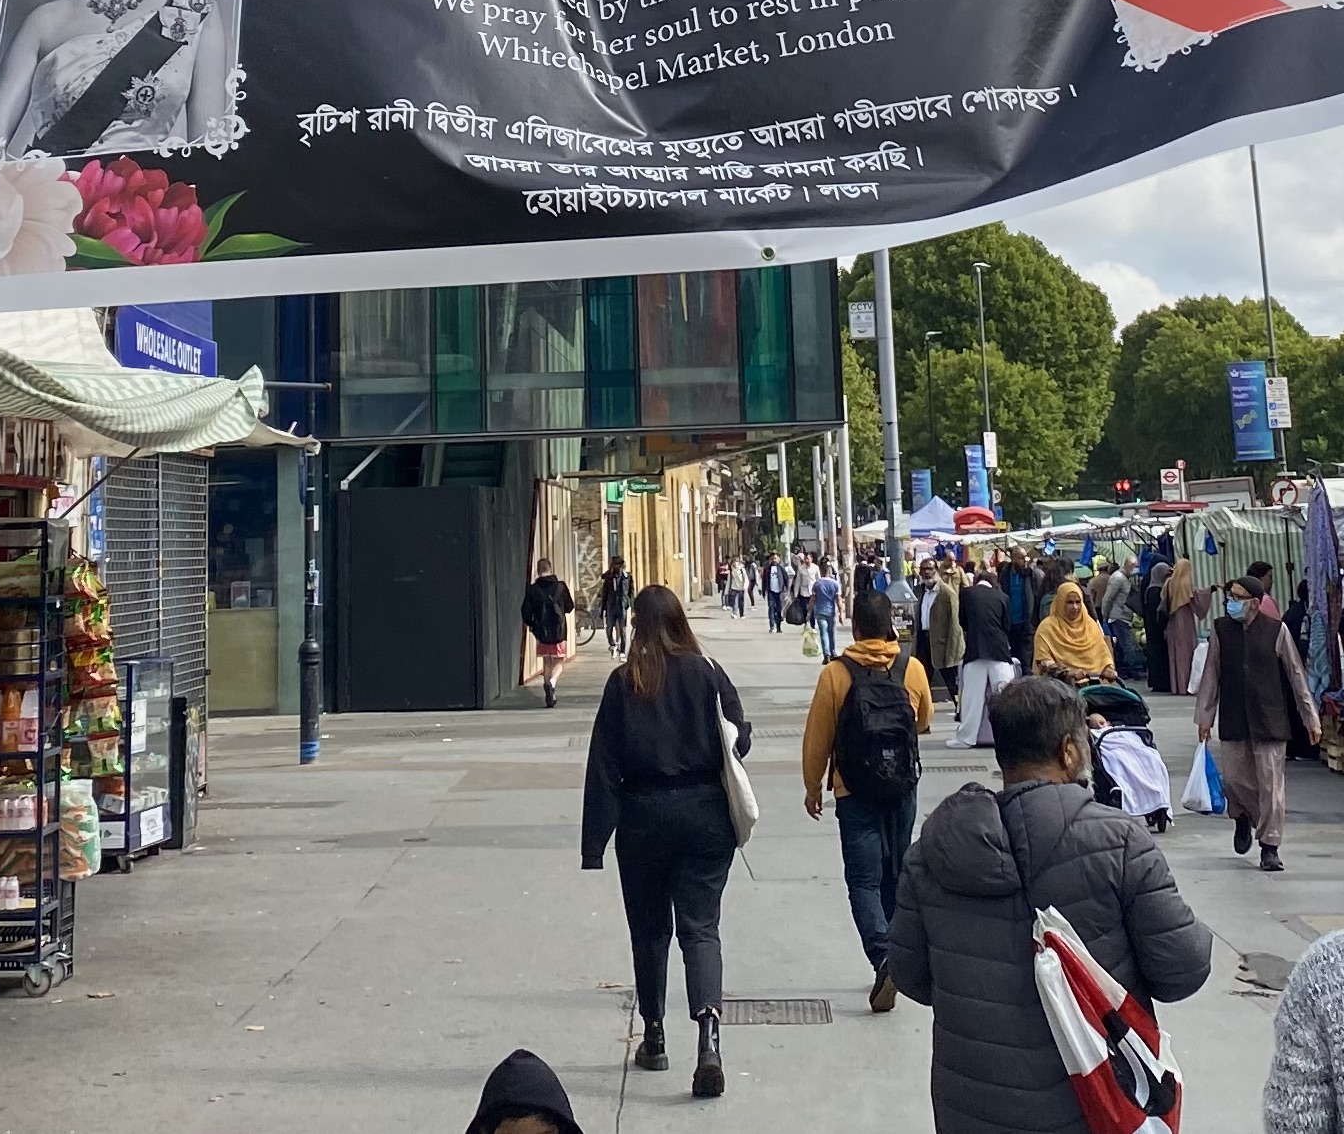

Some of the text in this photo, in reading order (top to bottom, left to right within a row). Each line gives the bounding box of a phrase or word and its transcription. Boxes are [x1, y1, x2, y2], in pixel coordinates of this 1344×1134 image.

[483, 2, 547, 34] pray
[554, 10, 586, 44] for
[591, 31, 637, 56] her
[645, 8, 701, 48] soul
[709, 6, 738, 28] to
[478, 20, 895, 94] Whitechapel Market, London
[297, 104, 360, 147] বৃটিশ
[366, 98, 419, 131] রানী
[424, 102, 498, 140] দ্বিতীয়
[506, 115, 654, 157] এলিজাবেথের
[659, 131, 744, 161] মৃত্যুতে
[749, 113, 825, 149] আমরা
[833, 98, 952, 135] গভীরভাবে
[962, 86, 1061, 112] শোকাহত
[464, 154, 542, 174] আমরা
[759, 155, 835, 179] কামনা
[840, 140, 910, 174] করছি
[850, 303, 873, 311] CCTV
[136, 321, 202, 374] WHOLESALE OUTLET
